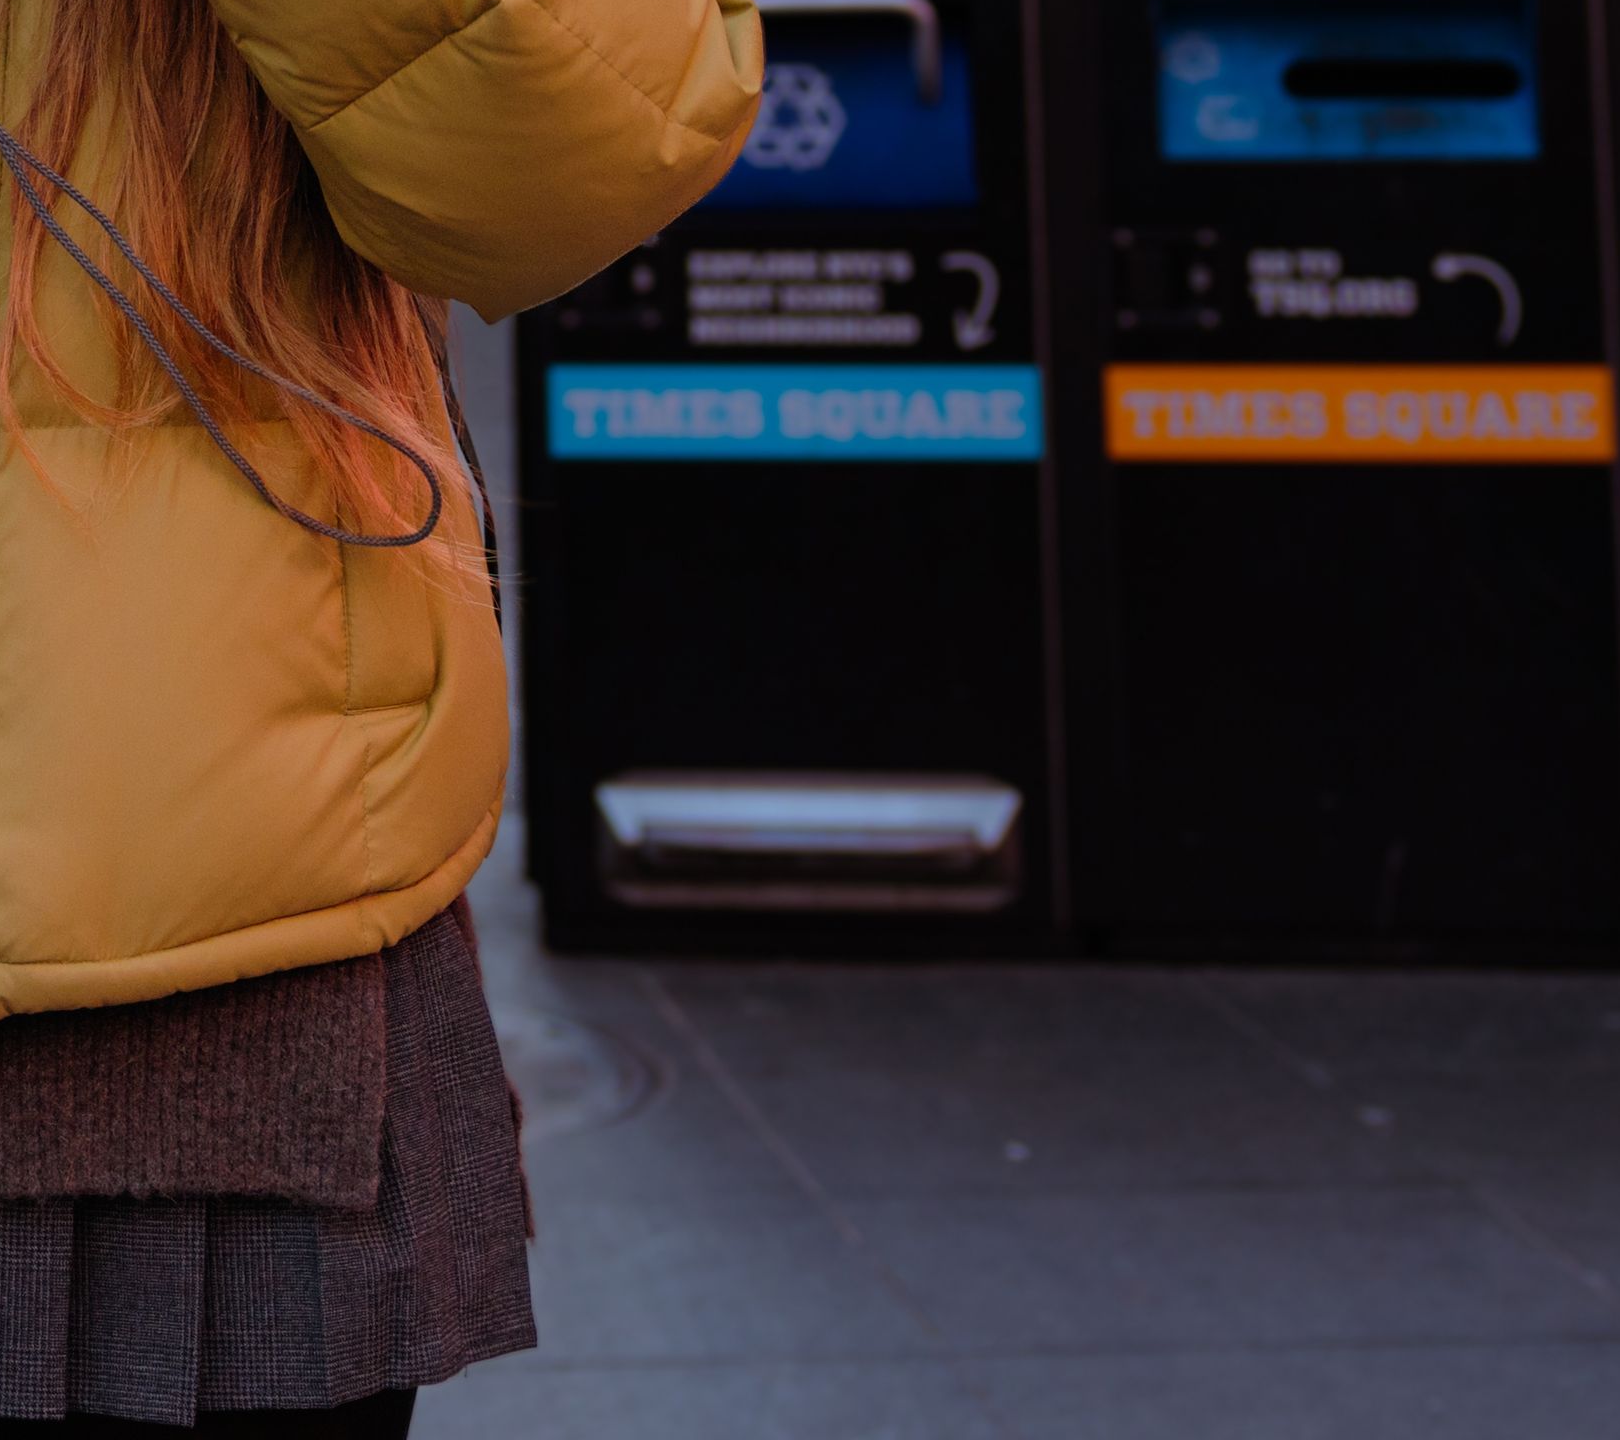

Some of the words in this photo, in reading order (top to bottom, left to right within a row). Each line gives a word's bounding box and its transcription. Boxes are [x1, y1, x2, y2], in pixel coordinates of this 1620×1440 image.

[565, 389, 763, 438] TIMES
[779, 389, 1025, 441] SQUARE
[1122, 390, 1327, 439] TIMES
[1344, 391, 1597, 443] SQUARE
